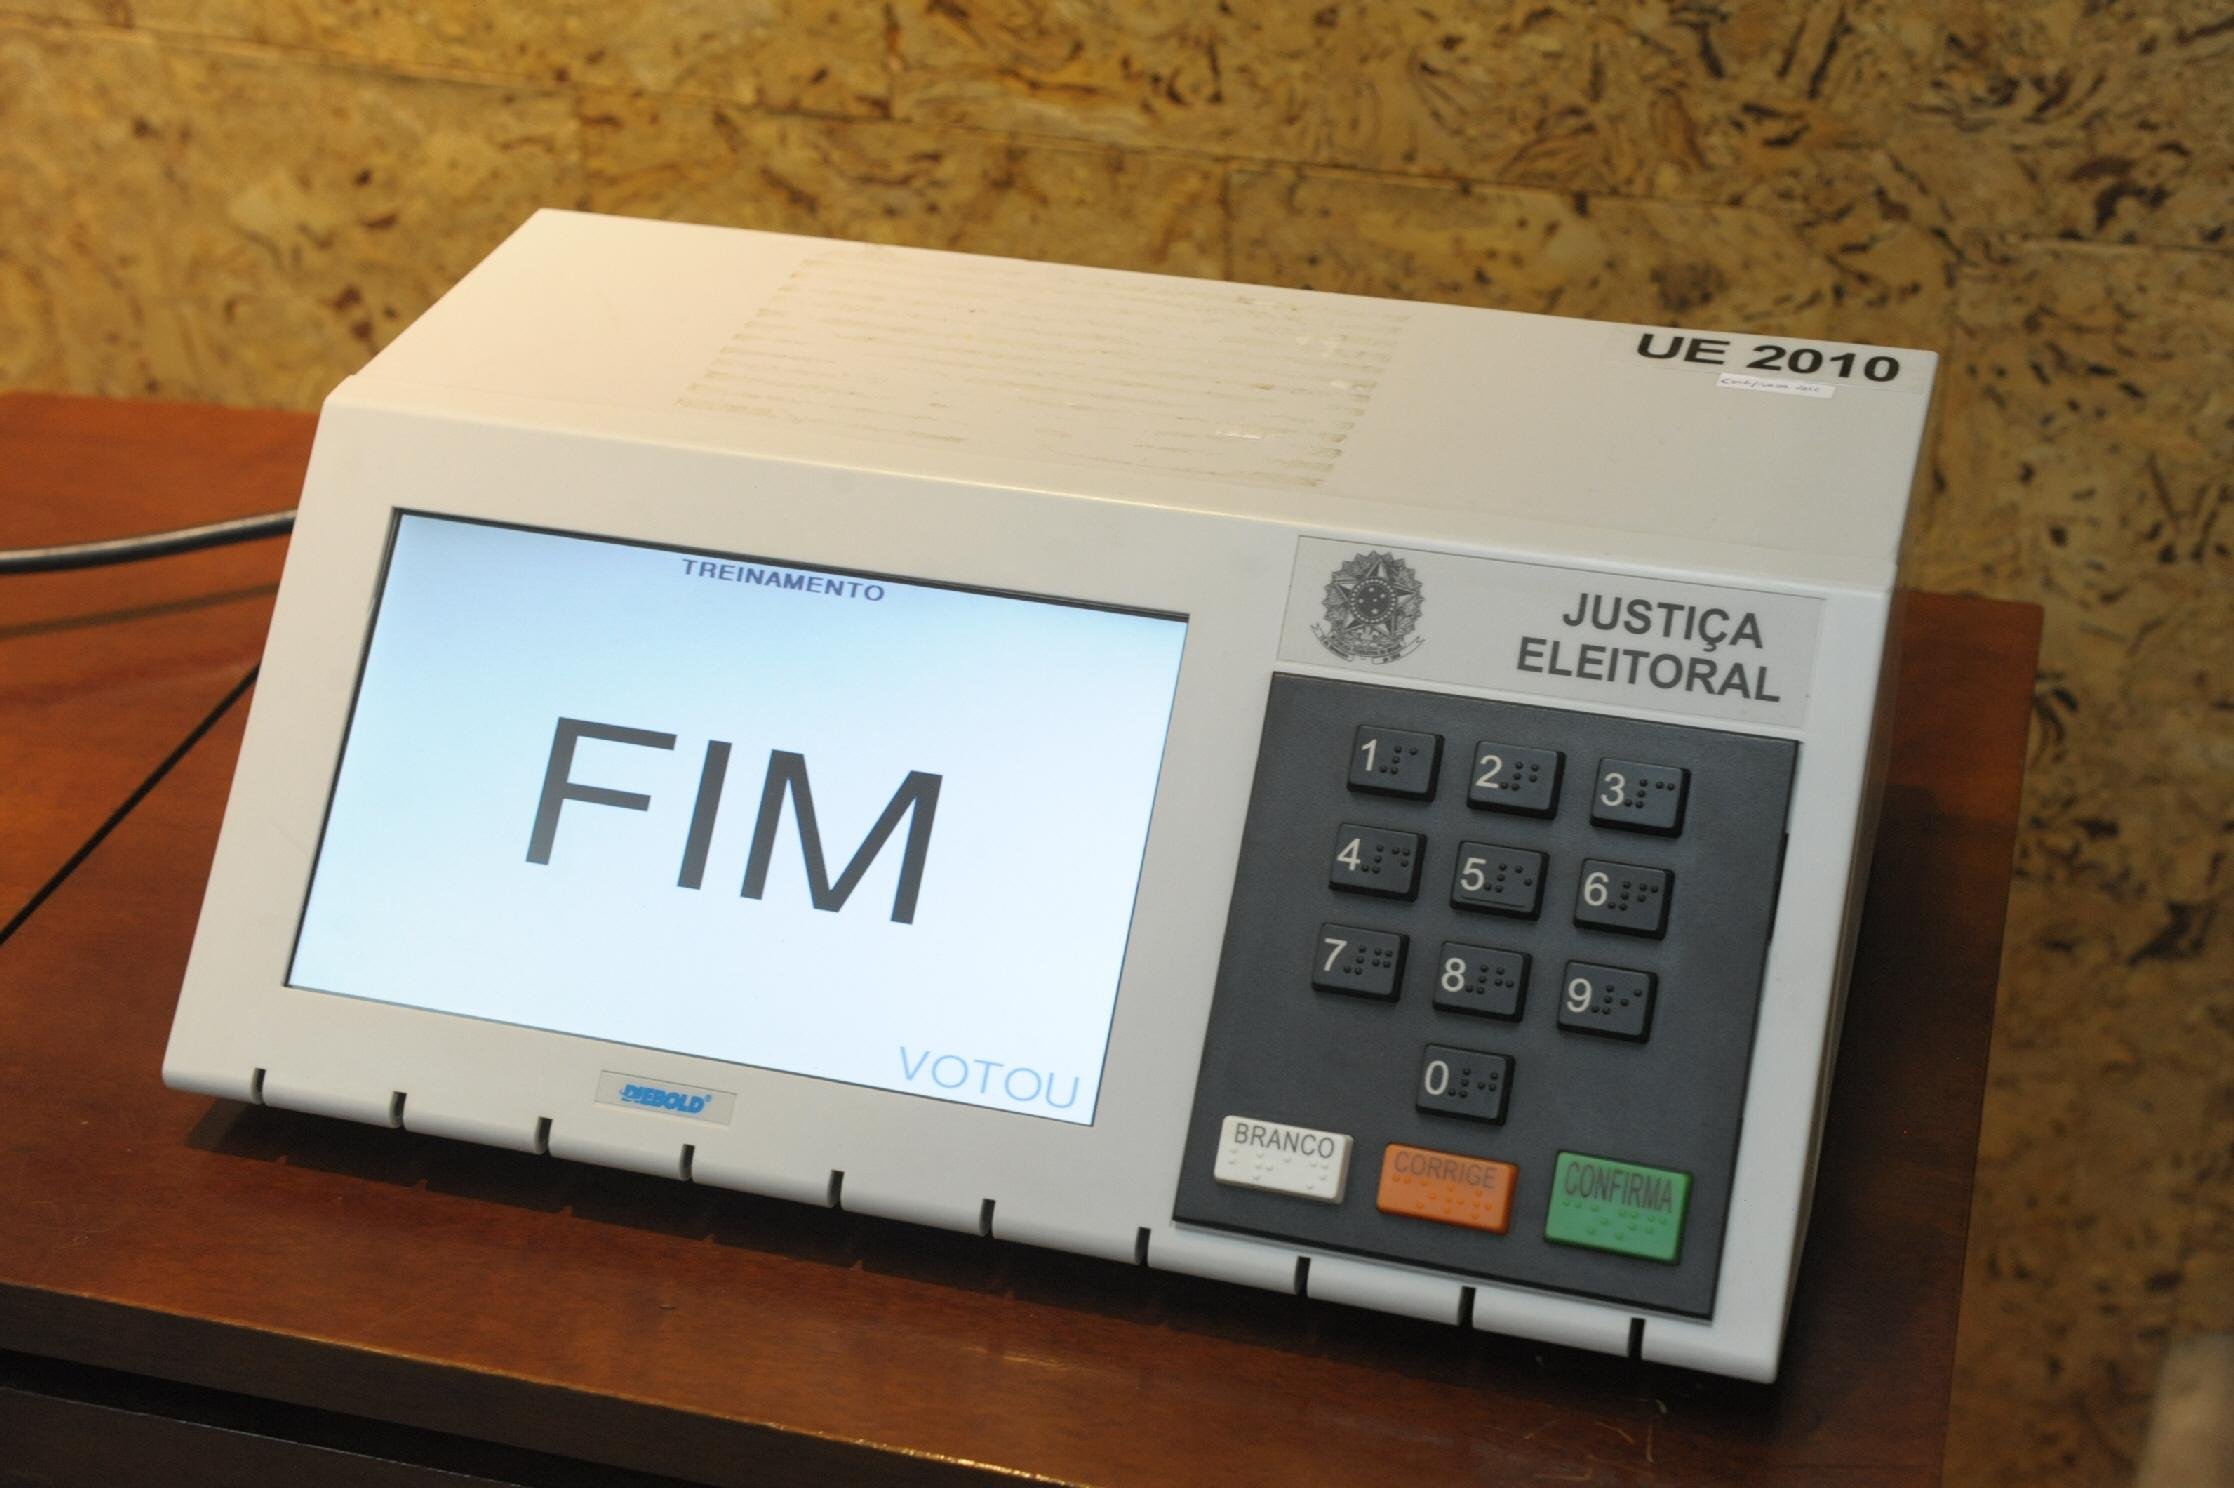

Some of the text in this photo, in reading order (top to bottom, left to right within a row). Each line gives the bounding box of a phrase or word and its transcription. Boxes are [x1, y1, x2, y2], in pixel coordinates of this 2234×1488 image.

[1637, 334, 1899, 382] UE 2010
[682, 559, 885, 601] TREINAMENTO
[1563, 593, 1763, 652] JUSTIÇA
[1517, 637, 1780, 702] ELEITORAL
[1361, 739, 1377, 772] 1
[1475, 755, 1503, 788] 2
[1600, 772, 1626, 806] 3
[525, 717, 943, 924] FIM
[1336, 838, 1361, 871] 4
[1460, 858, 1487, 891] 5
[1584, 872, 1610, 906] 6
[1323, 938, 1347, 971] 7
[1441, 958, 1467, 992] 8
[1566, 978, 1592, 1013] 9
[900, 1045, 1080, 1108] VOTOU
[1425, 1060, 1449, 1095] 0
[1234, 1123, 1335, 1160] BRANCO
[1394, 1150, 1496, 1189] CORRIGE
[1564, 1161, 1674, 1213] CONFIRMA
